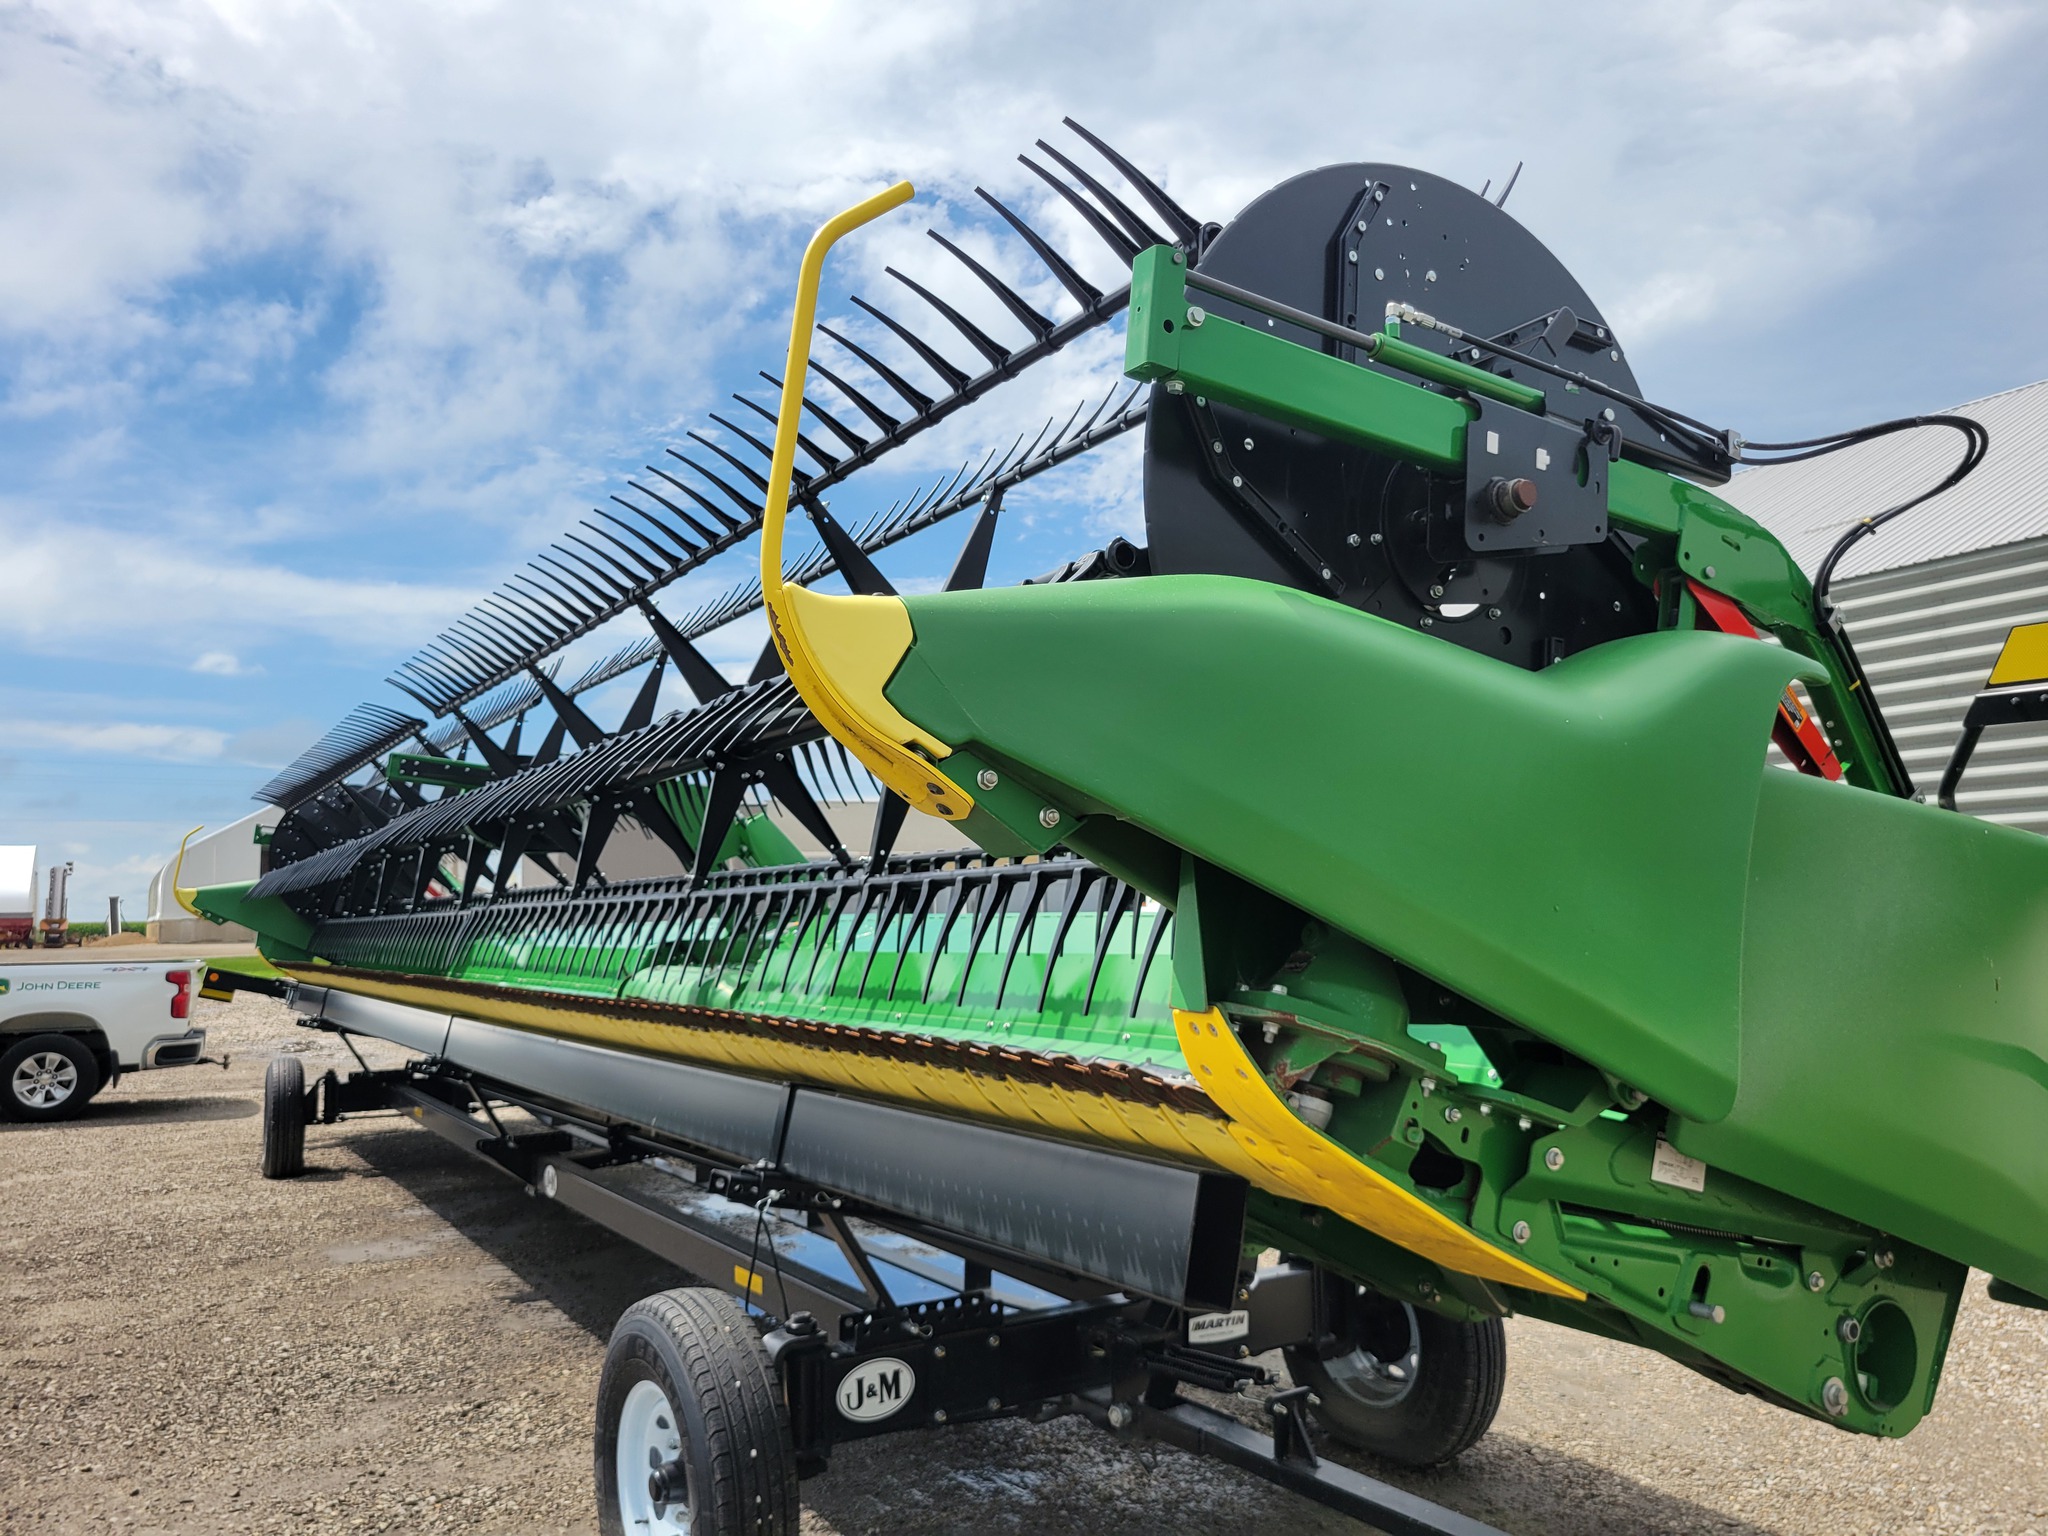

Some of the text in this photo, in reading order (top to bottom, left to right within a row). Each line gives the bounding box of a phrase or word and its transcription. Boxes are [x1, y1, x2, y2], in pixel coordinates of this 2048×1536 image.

[17, 981, 101, 992] JOHN DEERE
[1191, 1314, 1245, 1331] MARTIN
[846, 1368, 902, 1411] J&M
